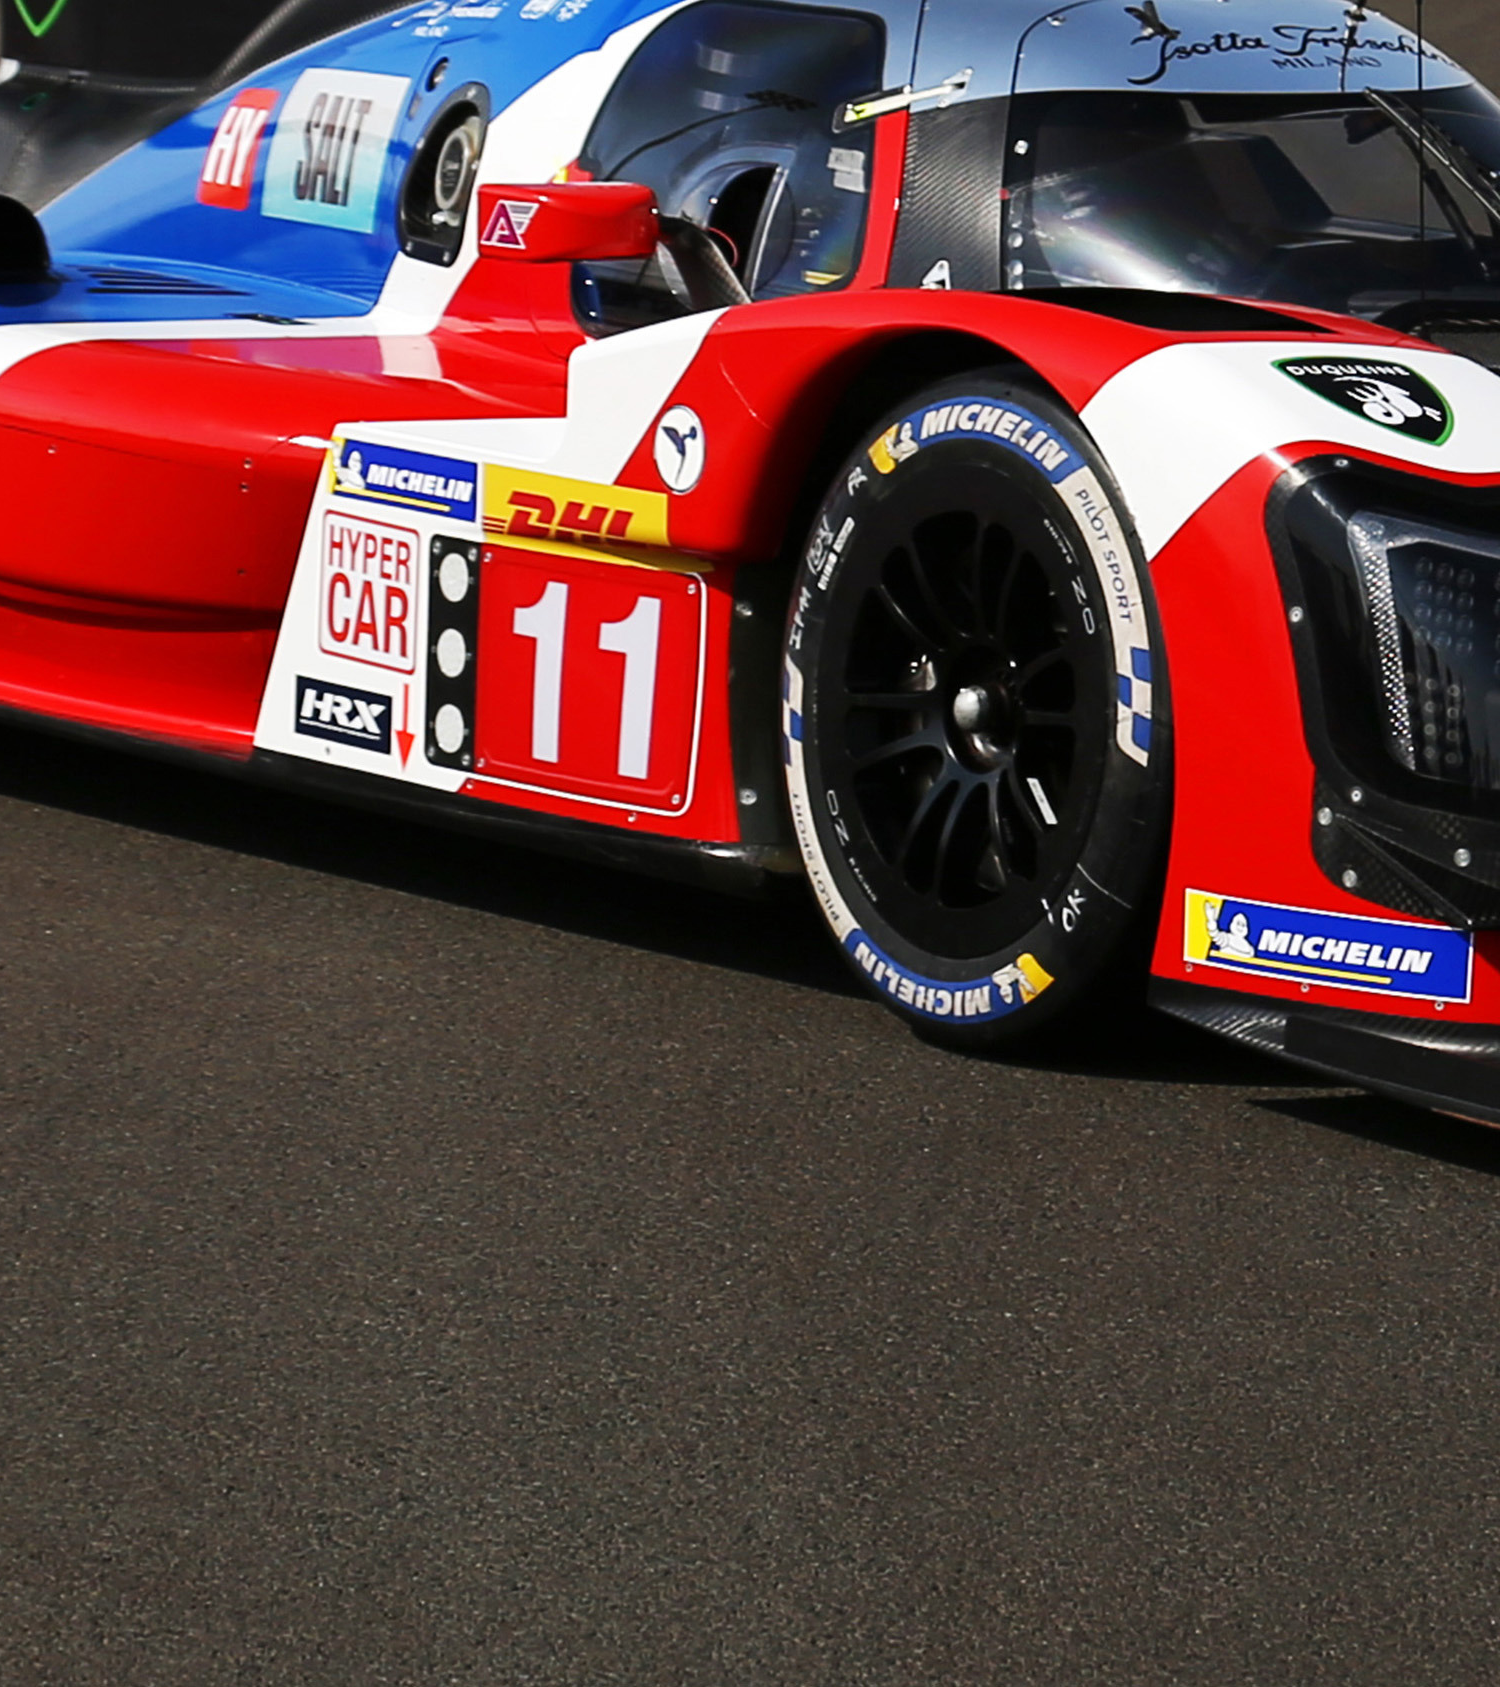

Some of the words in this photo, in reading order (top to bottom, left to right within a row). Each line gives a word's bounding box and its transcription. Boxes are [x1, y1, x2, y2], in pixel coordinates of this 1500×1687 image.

[202, 106, 270, 187] HY
[294, 92, 374, 207] SALT
[1285, 364, 1411, 376] DUQUEINE
[919, 403, 1070, 472] MICHELIN
[365, 462, 474, 503] MICHELIN
[506, 490, 636, 549] DHL
[328, 524, 411, 586] HYPER
[1075, 488, 1112, 542] PILOT
[1102, 549, 1133, 624] SPORT
[327, 572, 410, 659] CAR
[300, 687, 387, 736] HRX
[512, 580, 663, 780] 11
[853, 941, 993, 1017] MICHELIN
[1258, 928, 1433, 975] MICHELIN
